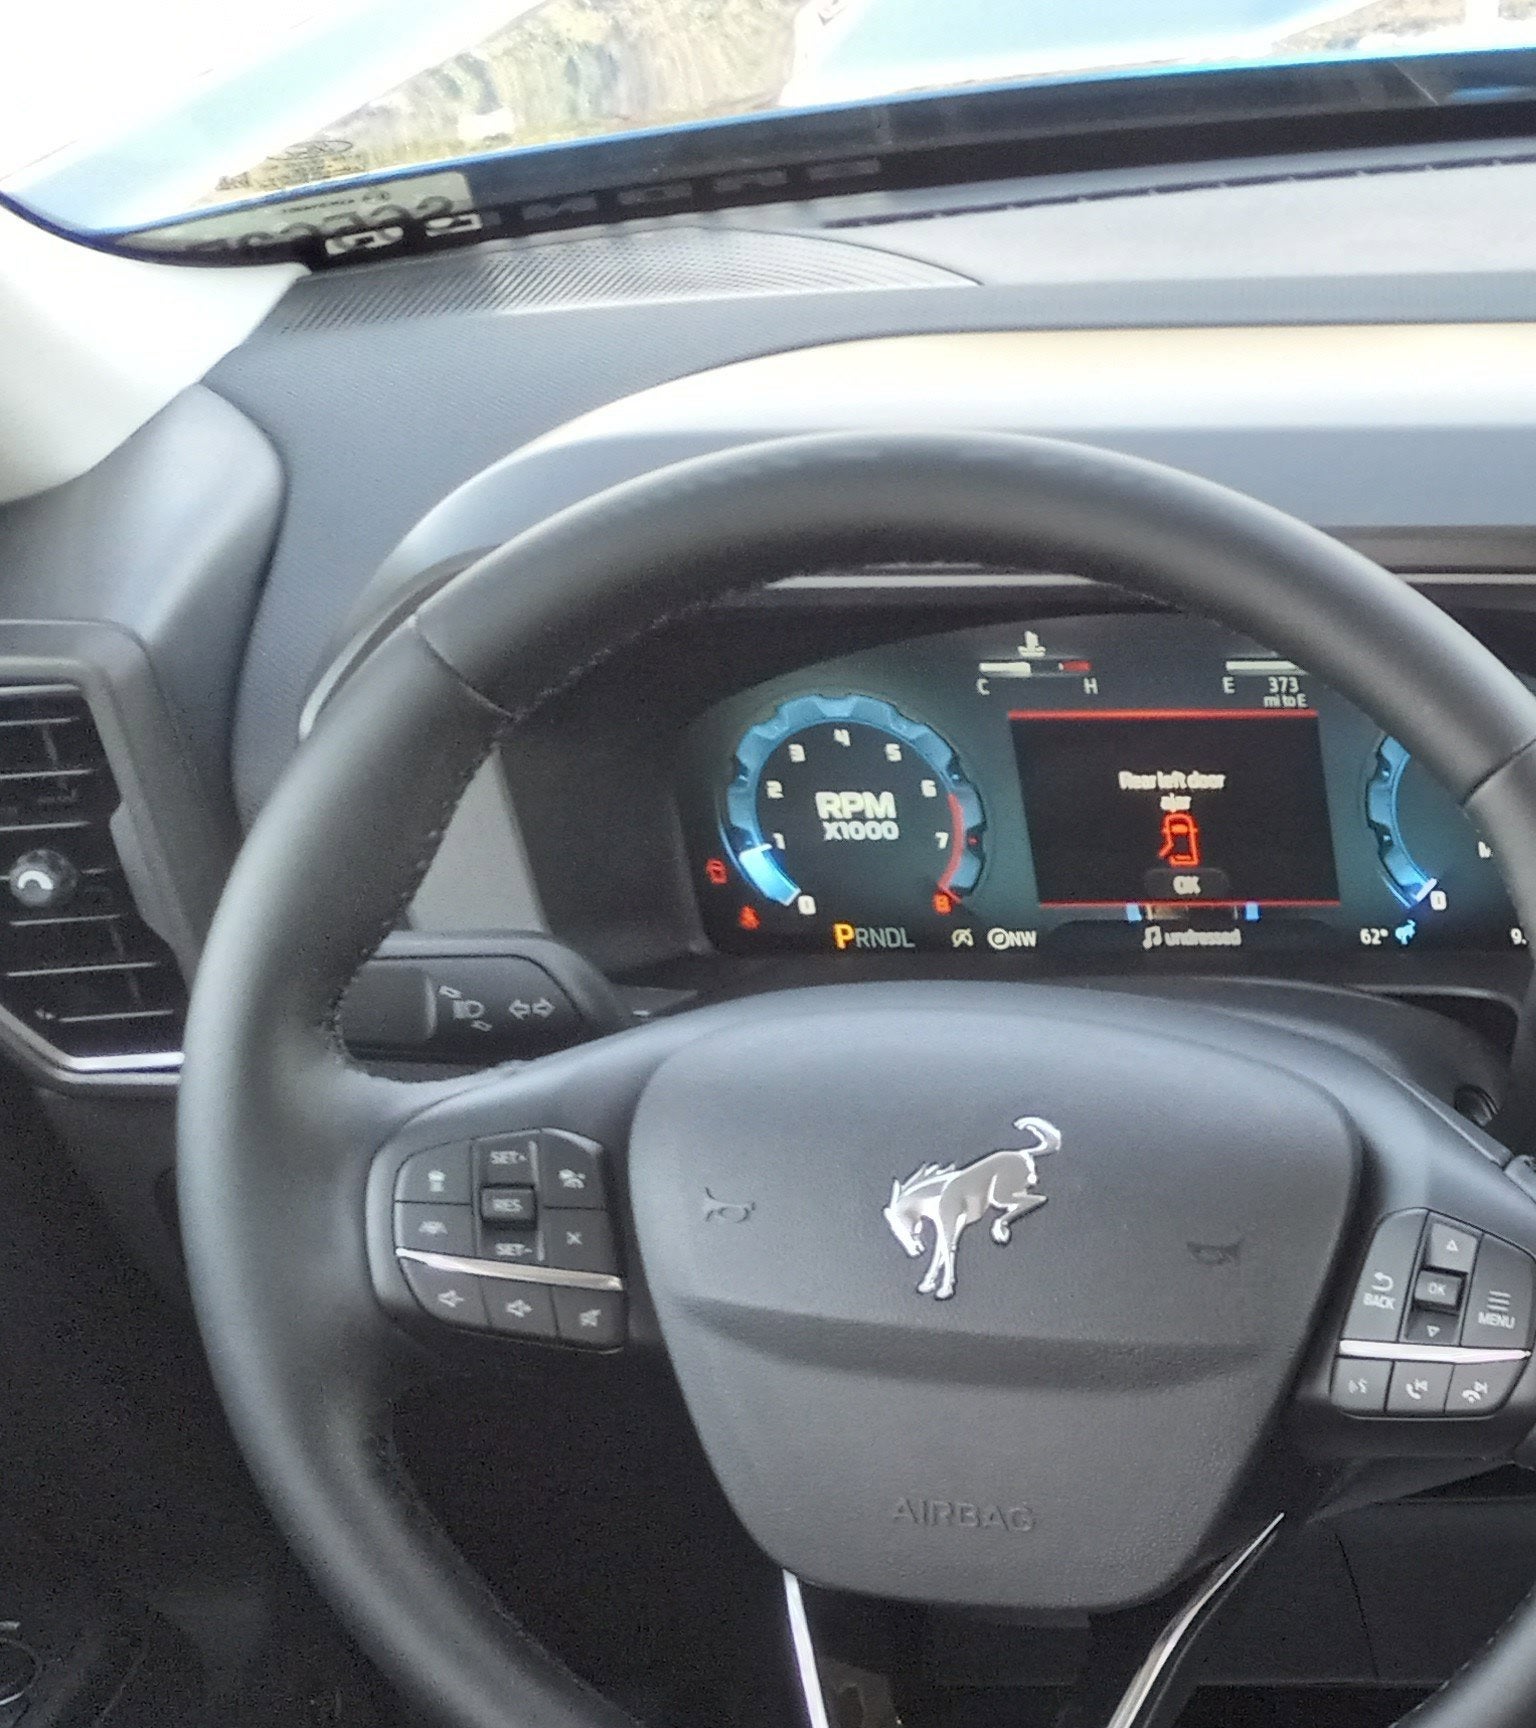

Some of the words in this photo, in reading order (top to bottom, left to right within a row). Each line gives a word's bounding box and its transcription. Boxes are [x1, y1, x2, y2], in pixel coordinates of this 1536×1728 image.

[976, 678, 991, 695] C
[1084, 678, 1098, 695] H
[1223, 676, 1235, 694] E
[1268, 676, 1299, 693] 373
[833, 729, 850, 746] 4
[789, 744, 805, 762] 3
[885, 744, 901, 762] 5
[767, 781, 784, 798] 2
[920, 780, 937, 797] 6
[815, 790, 898, 819] RPM
[822, 820, 899, 841] X1000
[935, 832, 949, 849] 7
[1008, 930, 1037, 948] NW
[1360, 927, 1389, 945] 62°
[1428, 1282, 1447, 1296] OK
[1478, 1311, 1515, 1330] MENU
[893, 1497, 1037, 1532] AIRBAG
